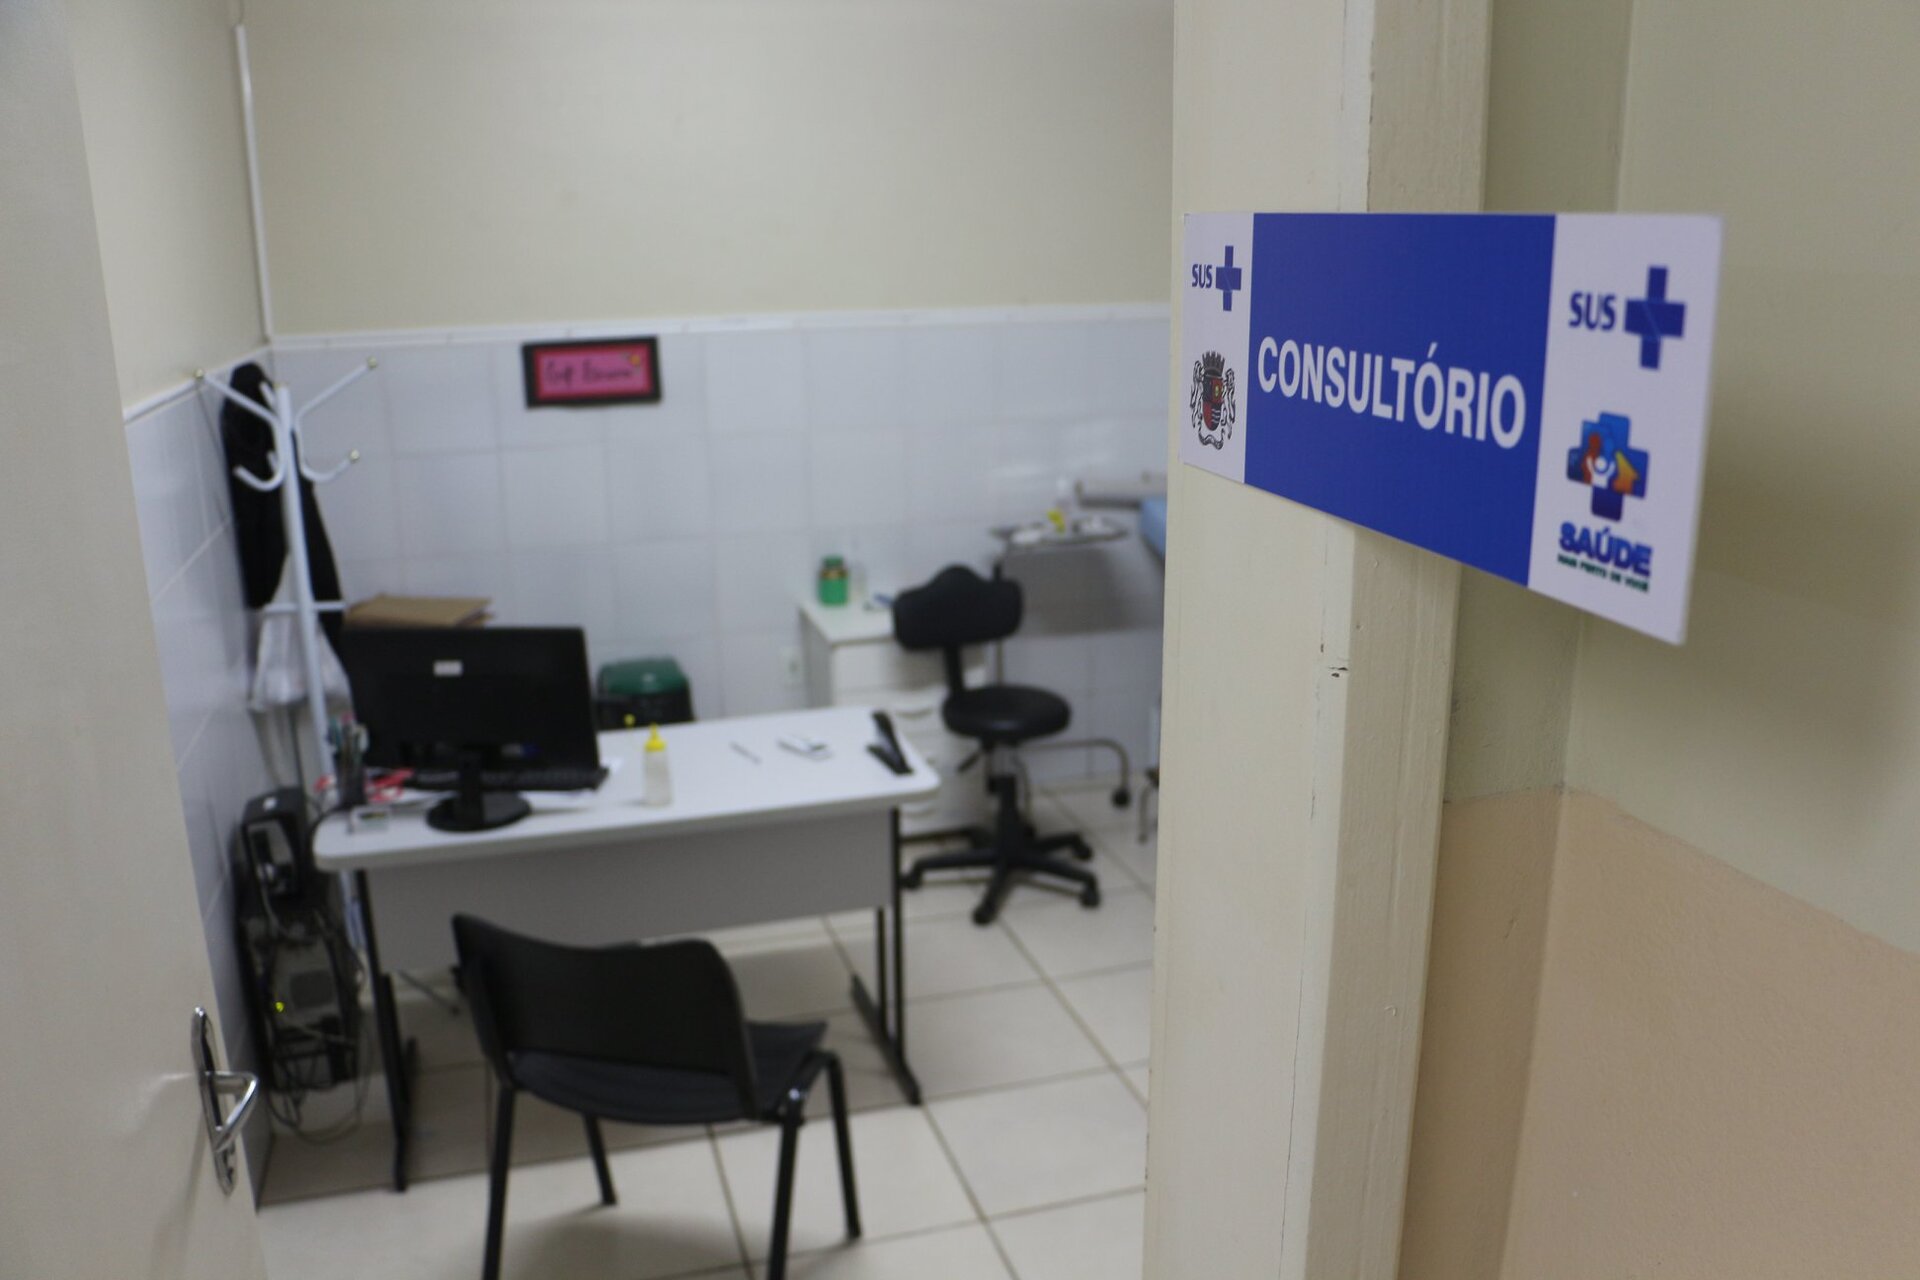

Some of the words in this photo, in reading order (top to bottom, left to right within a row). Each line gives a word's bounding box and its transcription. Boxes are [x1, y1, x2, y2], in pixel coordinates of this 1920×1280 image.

[1191, 263, 1213, 289] SUS
[1568, 291, 1617, 331] SUS
[1257, 336, 1526, 449] CONSULTÓRIO
[1559, 521, 1653, 577] SAÚDE
